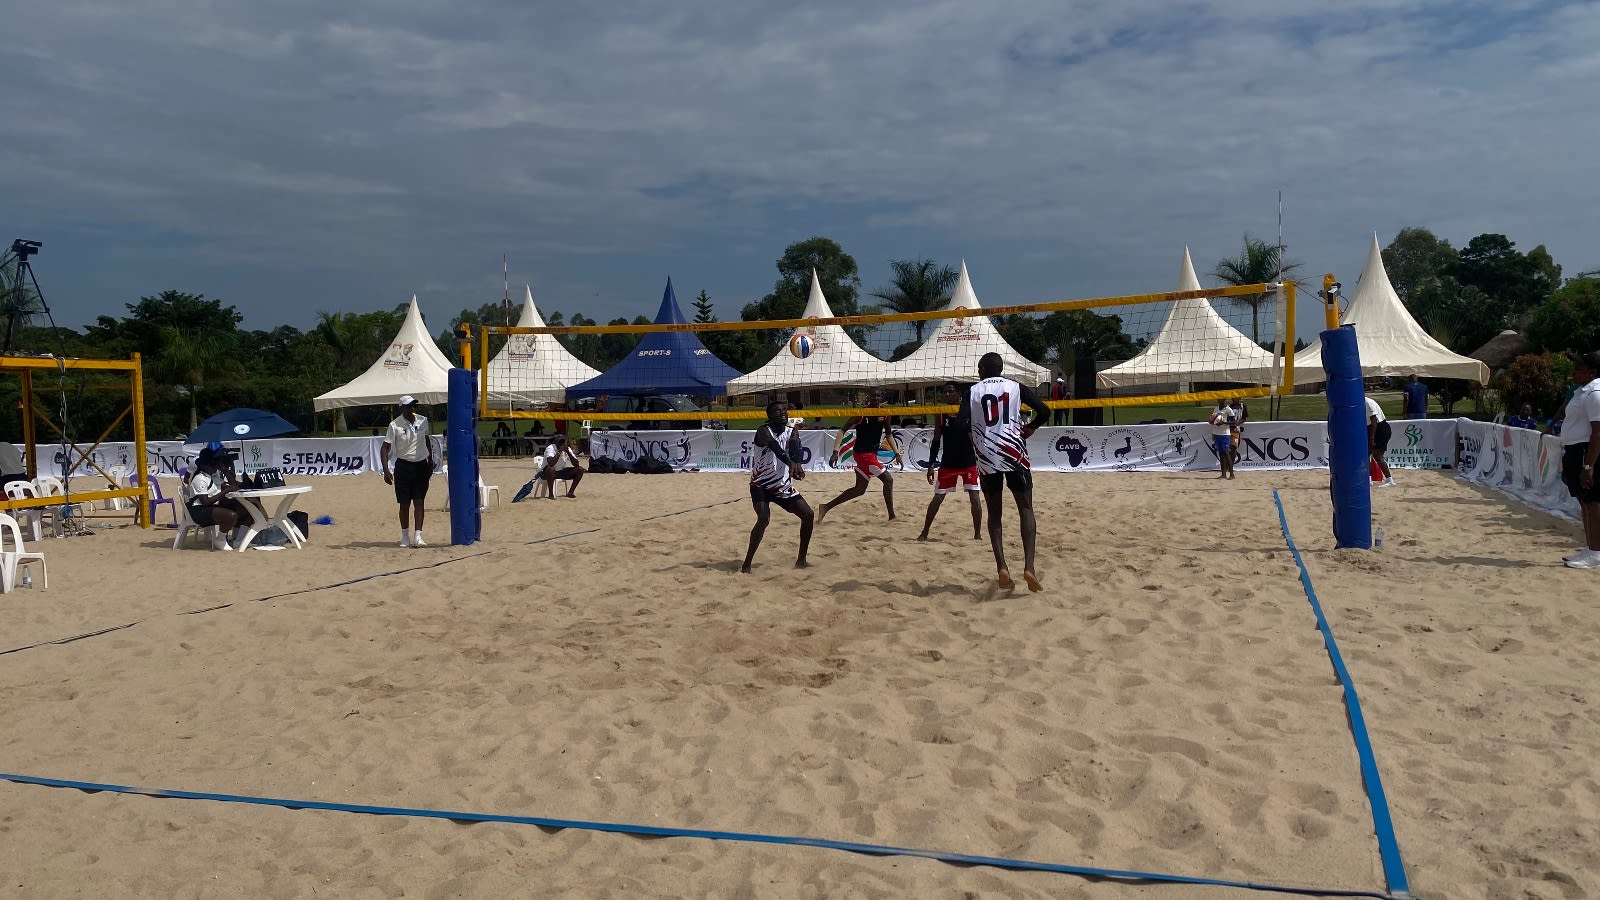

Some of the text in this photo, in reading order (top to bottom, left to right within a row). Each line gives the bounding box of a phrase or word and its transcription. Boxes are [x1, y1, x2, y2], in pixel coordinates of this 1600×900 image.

[980, 392, 1010, 427] 01
[1168, 425, 1186, 433] UVF
[1241, 436, 1310, 461] NCS
[282, 452, 337, 465] S-TEAM
[337, 456, 364, 471] HD
